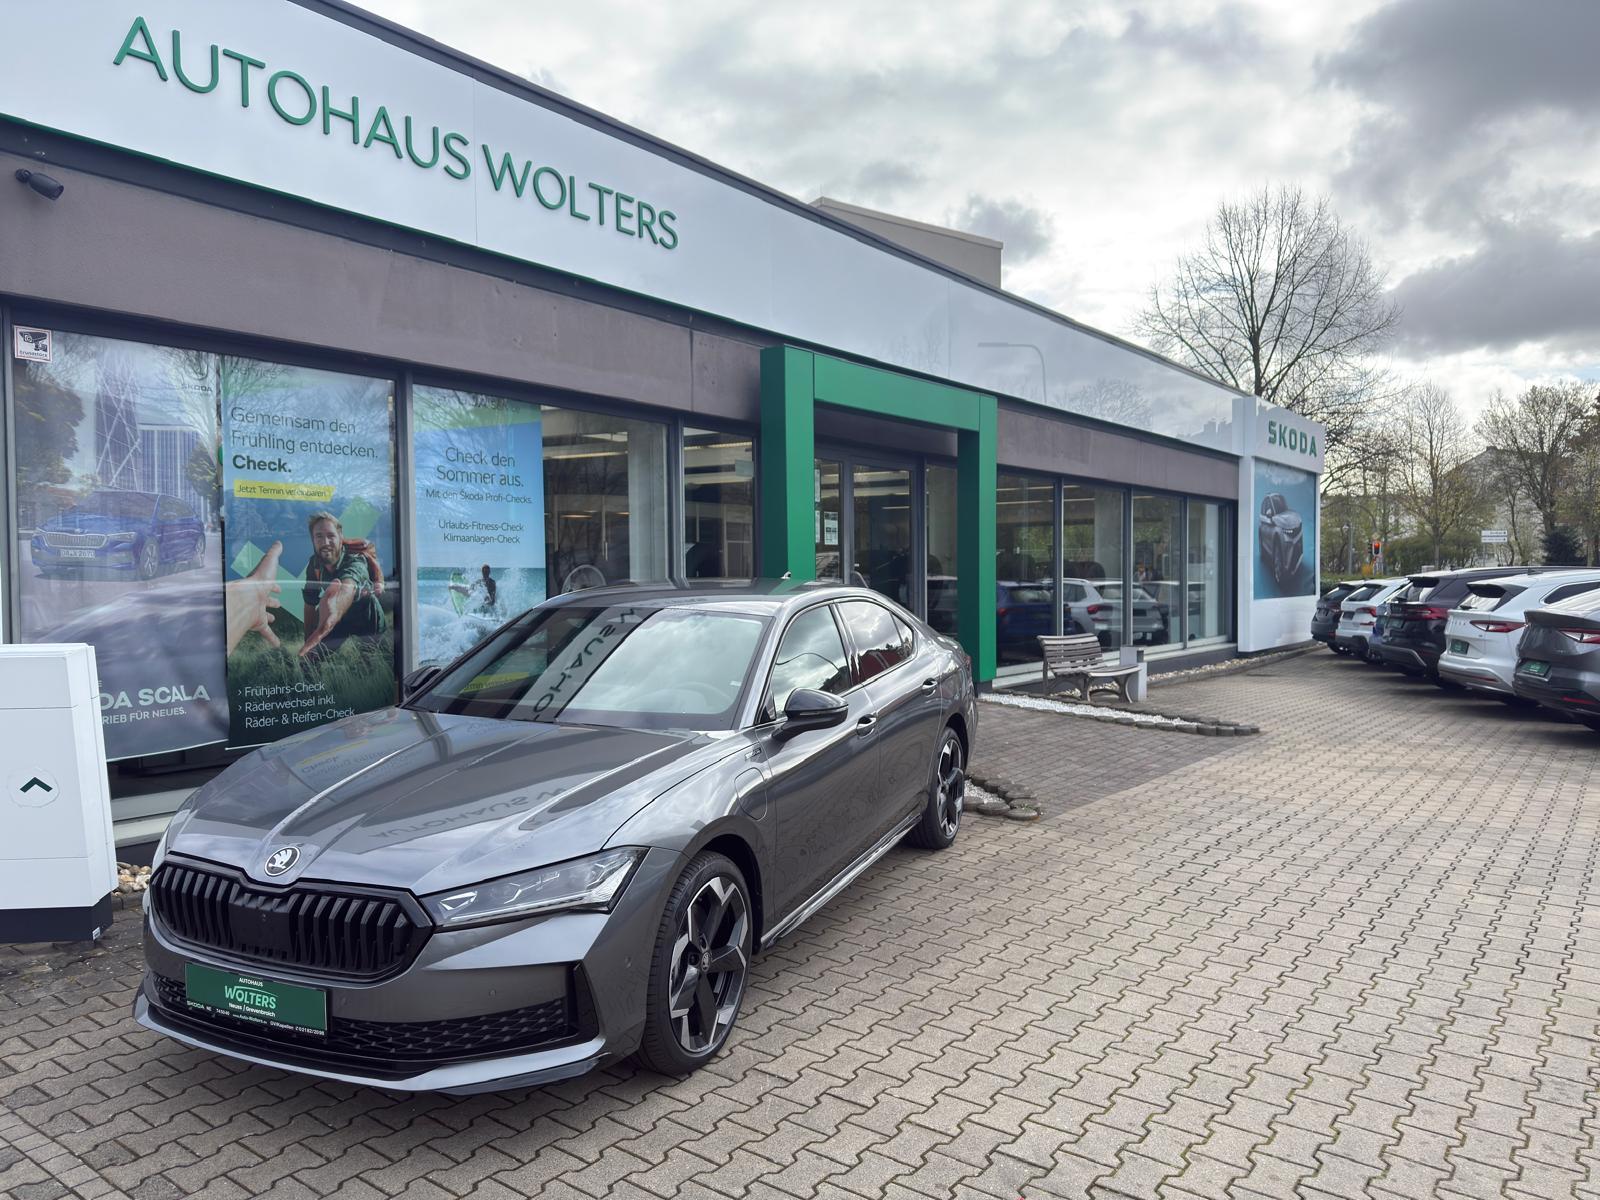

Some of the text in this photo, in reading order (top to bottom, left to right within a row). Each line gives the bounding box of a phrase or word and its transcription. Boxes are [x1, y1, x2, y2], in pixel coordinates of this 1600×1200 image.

[113, 16, 679, 250] AUTOHAUS WOLTERS
[231, 407, 356, 433] Gemeinsam den
[232, 430, 378, 459] Frühling entdecken.
[232, 454, 292, 473] Check.
[445, 447, 516, 468] Check den
[436, 465, 524, 488] Sommer aus.
[238, 485, 256, 494] Jetzt
[257, 485, 284, 496] Termin
[426, 488, 440, 498] Mit
[438, 519, 525, 532] Urlaubs-Fitness-Check
[443, 532, 521, 545] Klimaanlagen-Check
[137, 684, 211, 706] SCALA
[244, 682, 325, 698] Frühjahrs-Check
[245, 694, 336, 713] Räderwechsel inkl.
[129, 710, 150, 723] FÜR
[152, 706, 187, 719] NEUES.
[245, 707, 355, 729] Räder- & Reifen-Check
[238, 977, 264, 988] AUTOHAUS
[224, 985, 277, 1010] WOLTERS
